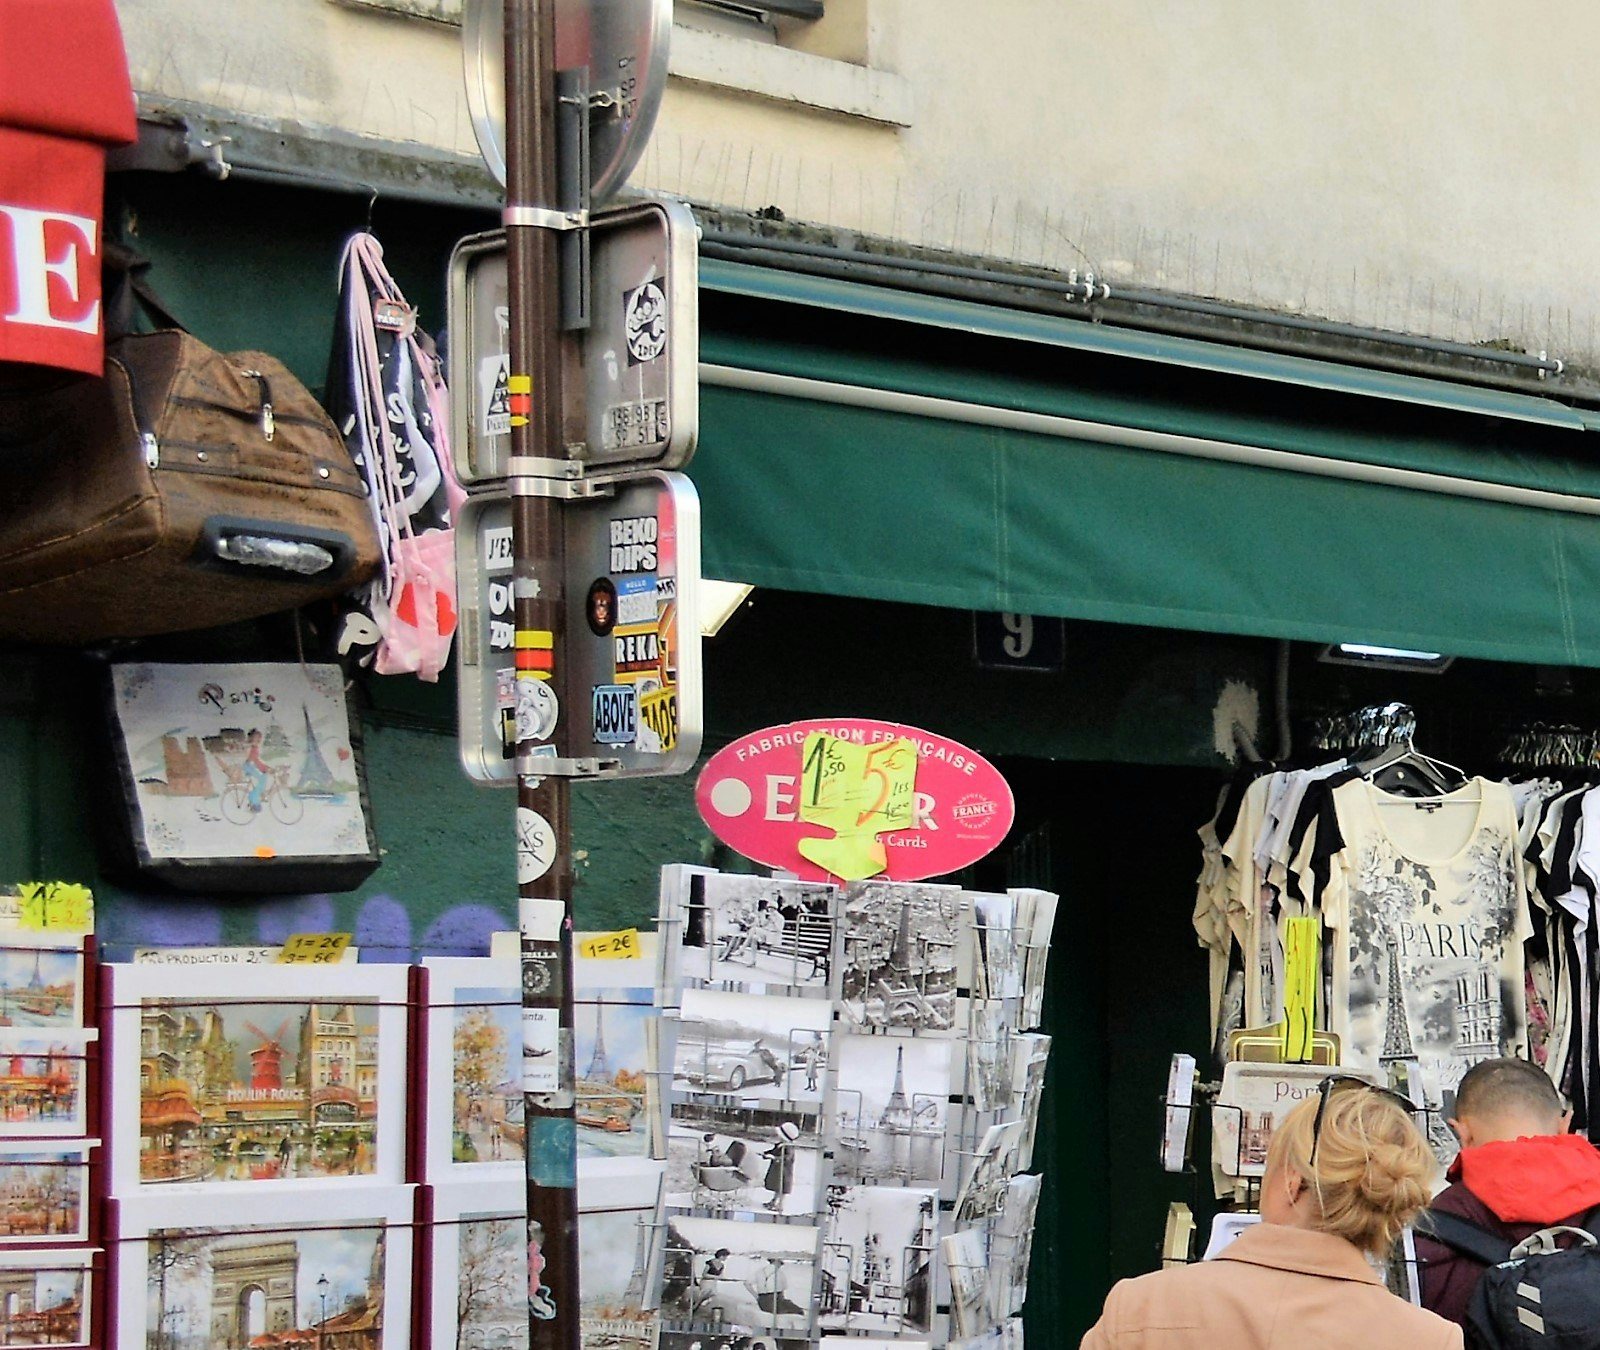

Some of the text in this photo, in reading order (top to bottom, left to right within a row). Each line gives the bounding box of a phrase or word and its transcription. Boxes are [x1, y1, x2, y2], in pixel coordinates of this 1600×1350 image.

[610, 517, 658, 547] BEKO
[610, 546, 657, 573] DIPS
[616, 635, 659, 663] REKA
[595, 691, 636, 734] ABOVE
[952, 803, 994, 818] FRANCE
[888, 834, 928, 849] Cards
[1400, 921, 1481, 963] PARIS
[227, 1087, 305, 1101] MOULIN ROUGE
[1275, 1082, 1317, 1101] Par
